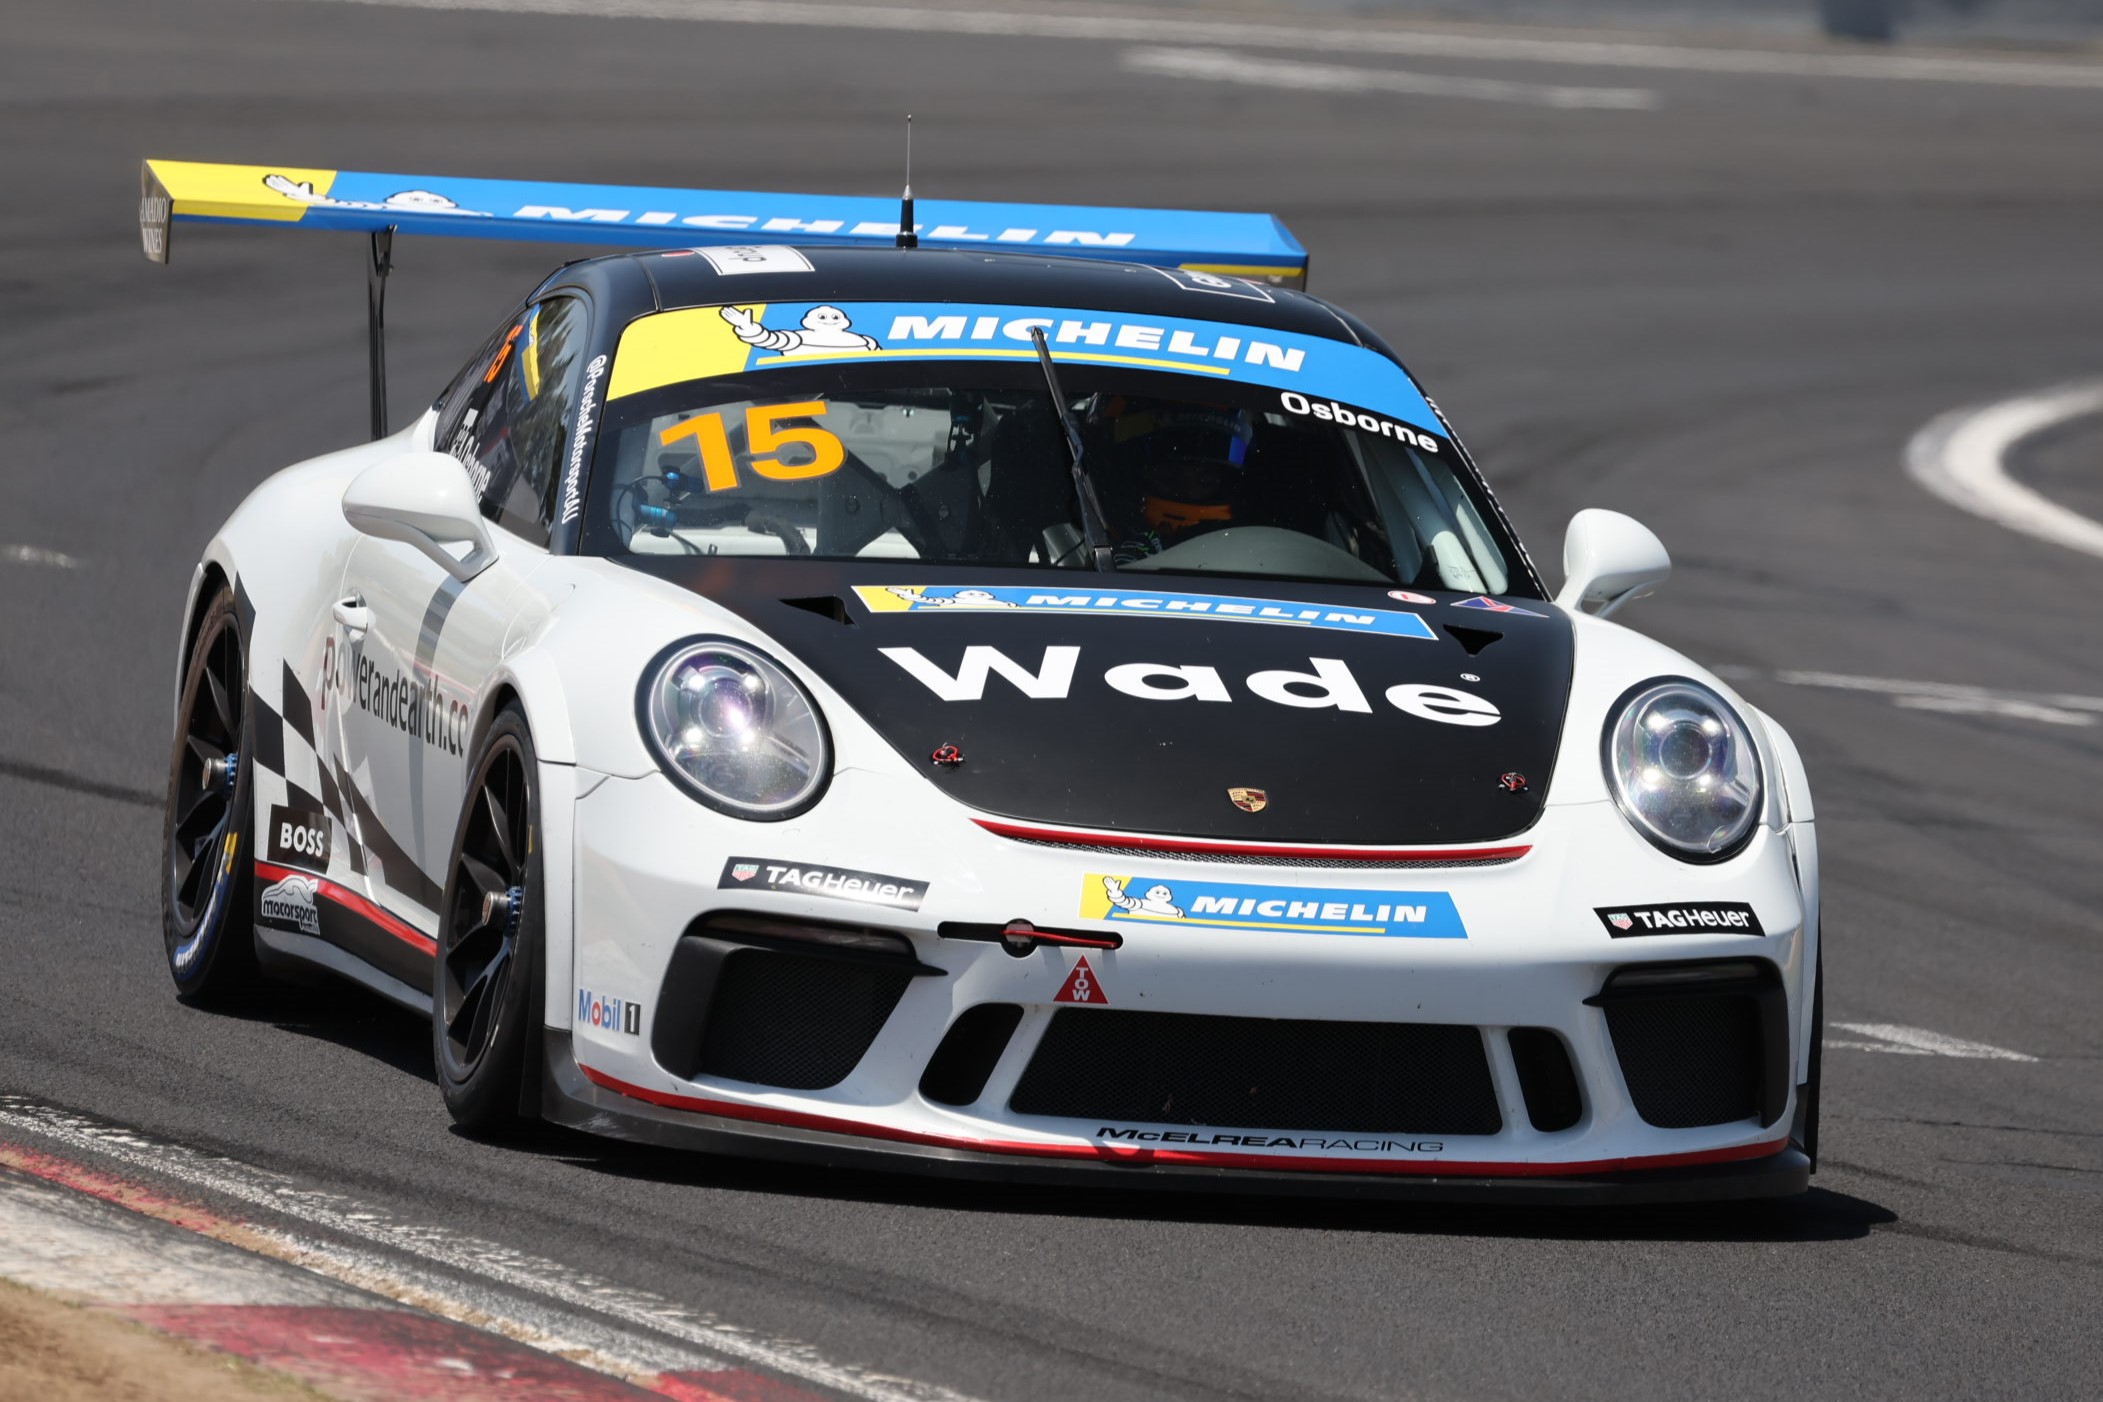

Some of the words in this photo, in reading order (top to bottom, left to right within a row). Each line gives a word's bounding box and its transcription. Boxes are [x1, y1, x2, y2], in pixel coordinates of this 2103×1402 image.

[142, 228, 163, 254] WINES
[512, 205, 1136, 246] MICHELIN
[887, 315, 1306, 372] MICHELIN
[1280, 391, 1439, 453] Osborne
[658, 400, 846, 493] 15
[1026, 595, 1376, 625] MICHELIN
[279, 821, 324, 858] BOSS
[1190, 896, 1428, 923] MICHELIN
[1072, 966, 1091, 1002] TOW
[578, 988, 621, 1032] Mobil
